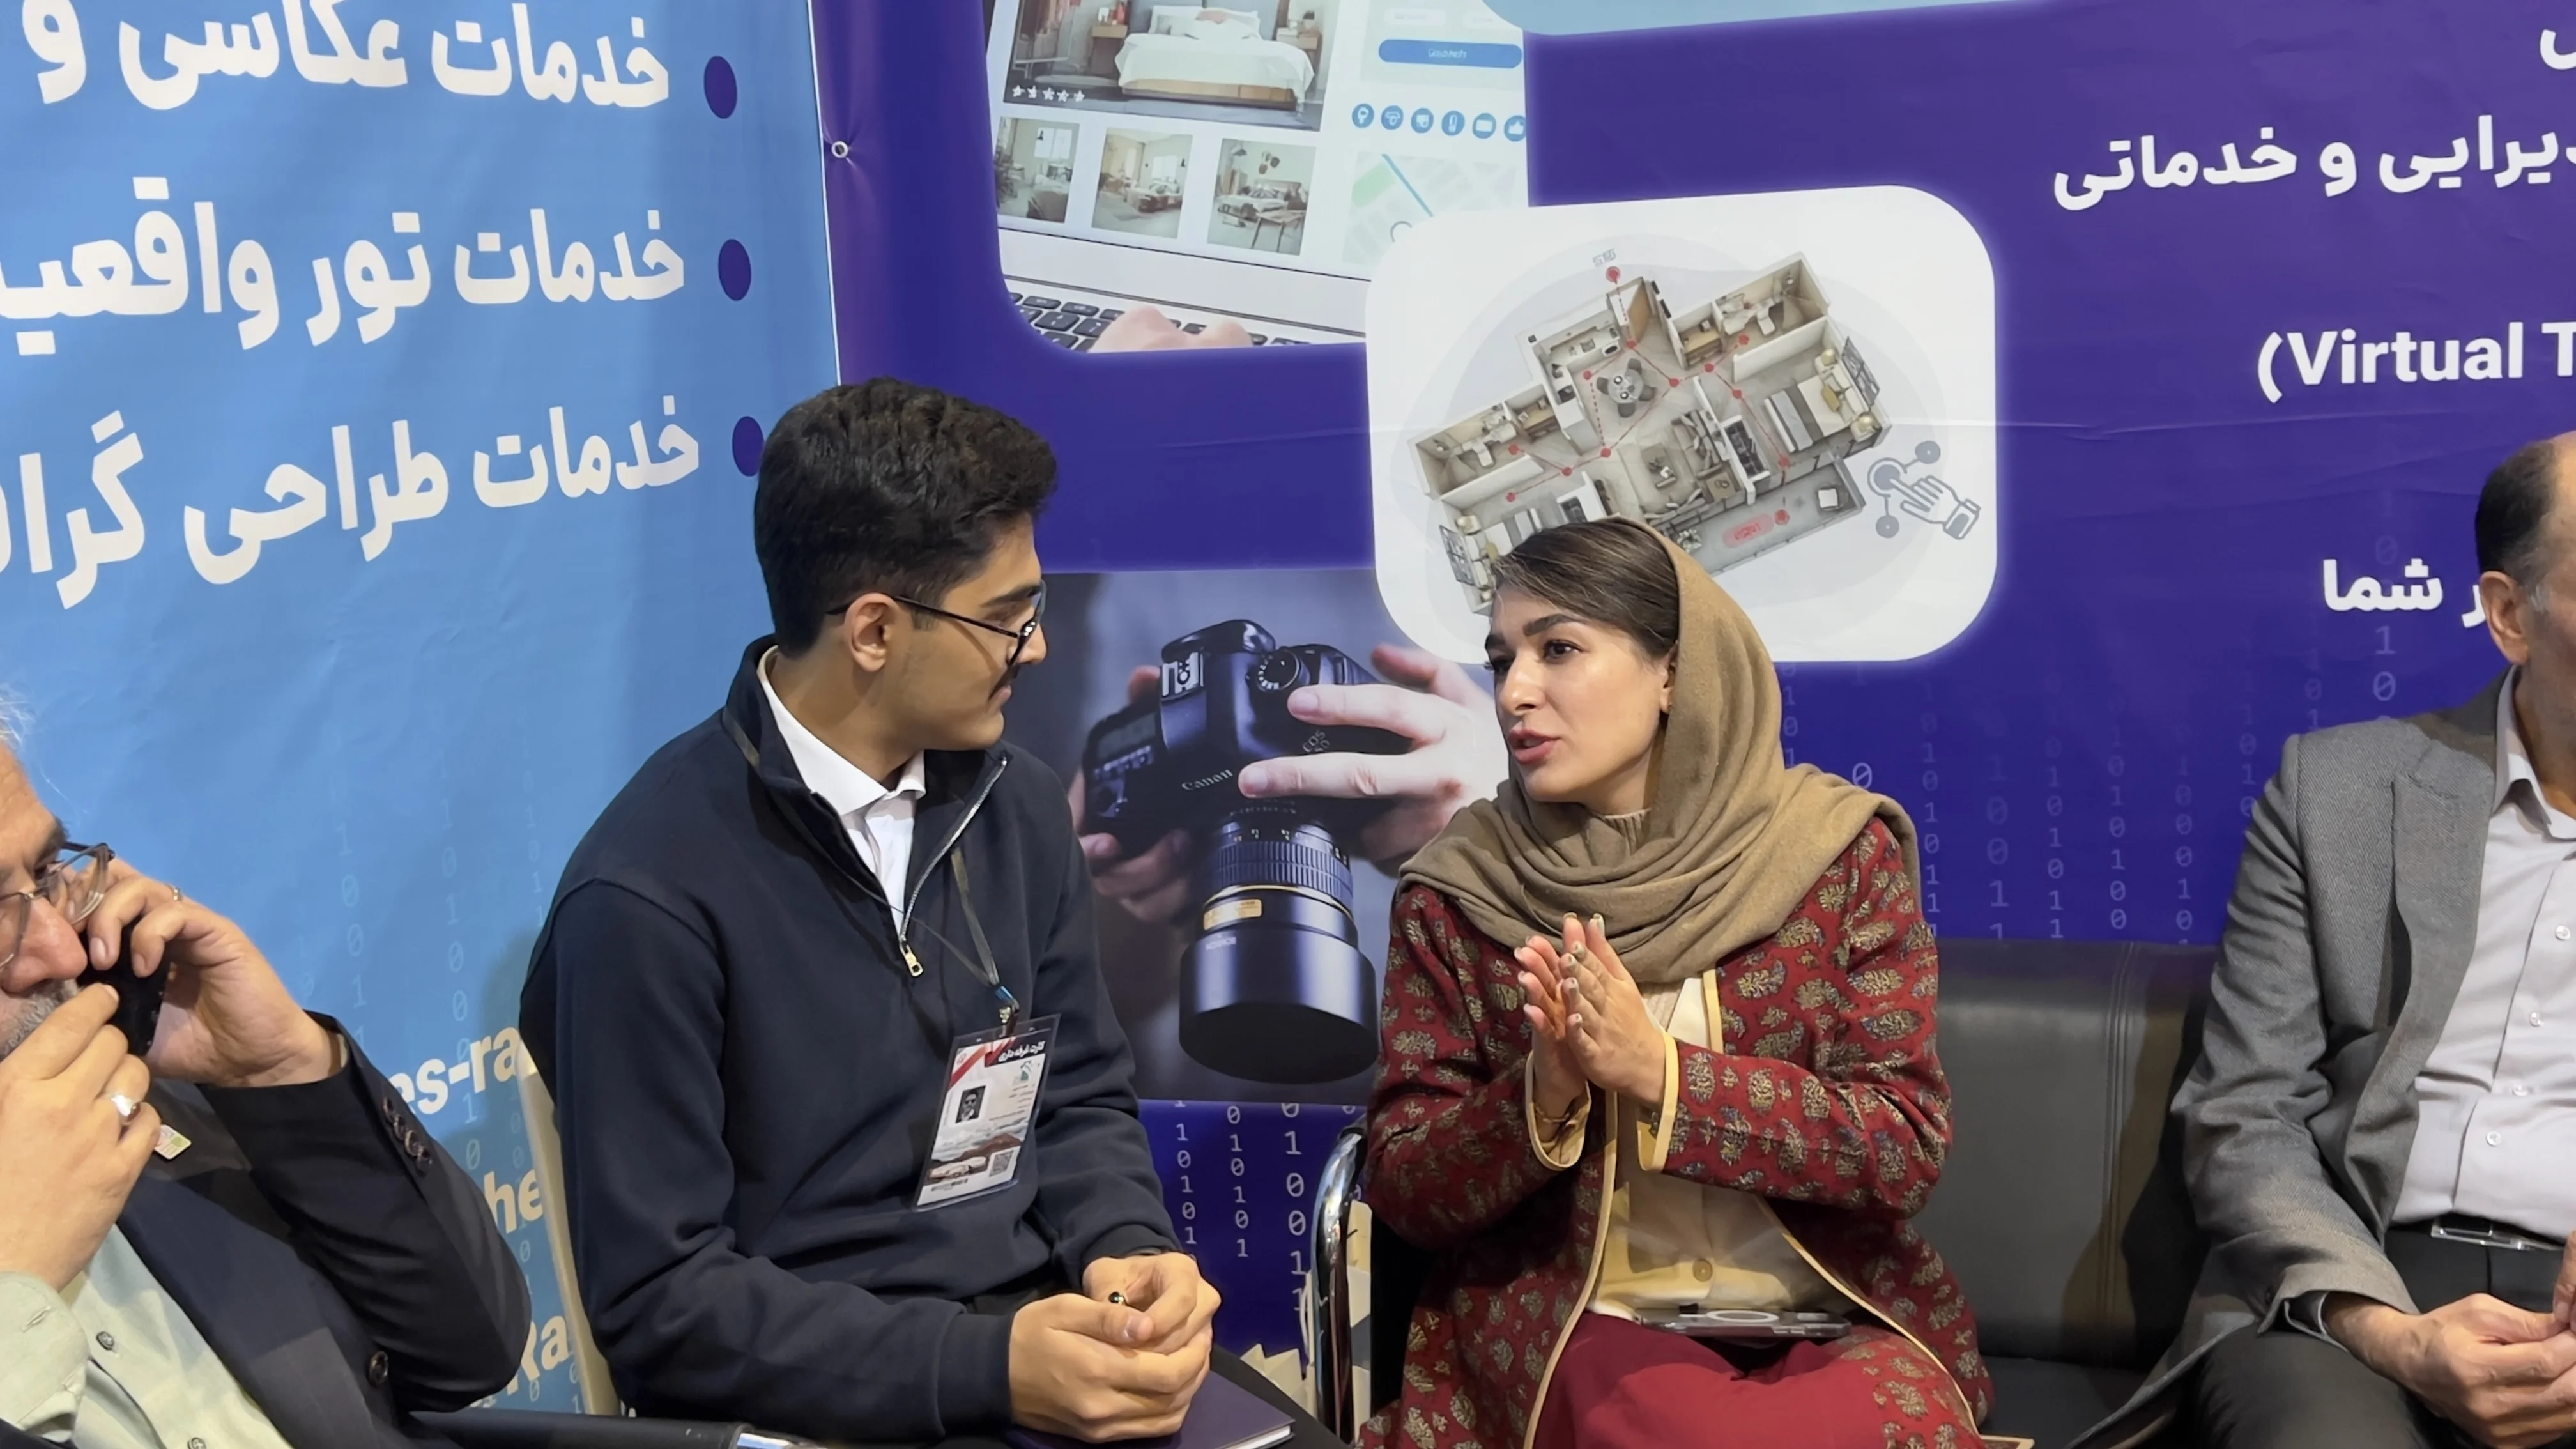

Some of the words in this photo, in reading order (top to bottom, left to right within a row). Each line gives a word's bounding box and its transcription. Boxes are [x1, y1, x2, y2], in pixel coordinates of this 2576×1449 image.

[22, 0, 86, 104] و
[119, 0, 408, 111] عکاسی
[432, 3, 668, 108] خدمات
[2054, 127, 2297, 210] خدماتی
[2320, 142, 2356, 197] و
[0, 177, 280, 356] واقعی
[454, 209, 684, 305] خدمات
[184, 420, 449, 585] طراحی
[473, 395, 699, 508] خدمات
[0, 411, 144, 610] گرا
[2324, 558, 2442, 611] شما
[1181, 769, 1234, 791] Canon
